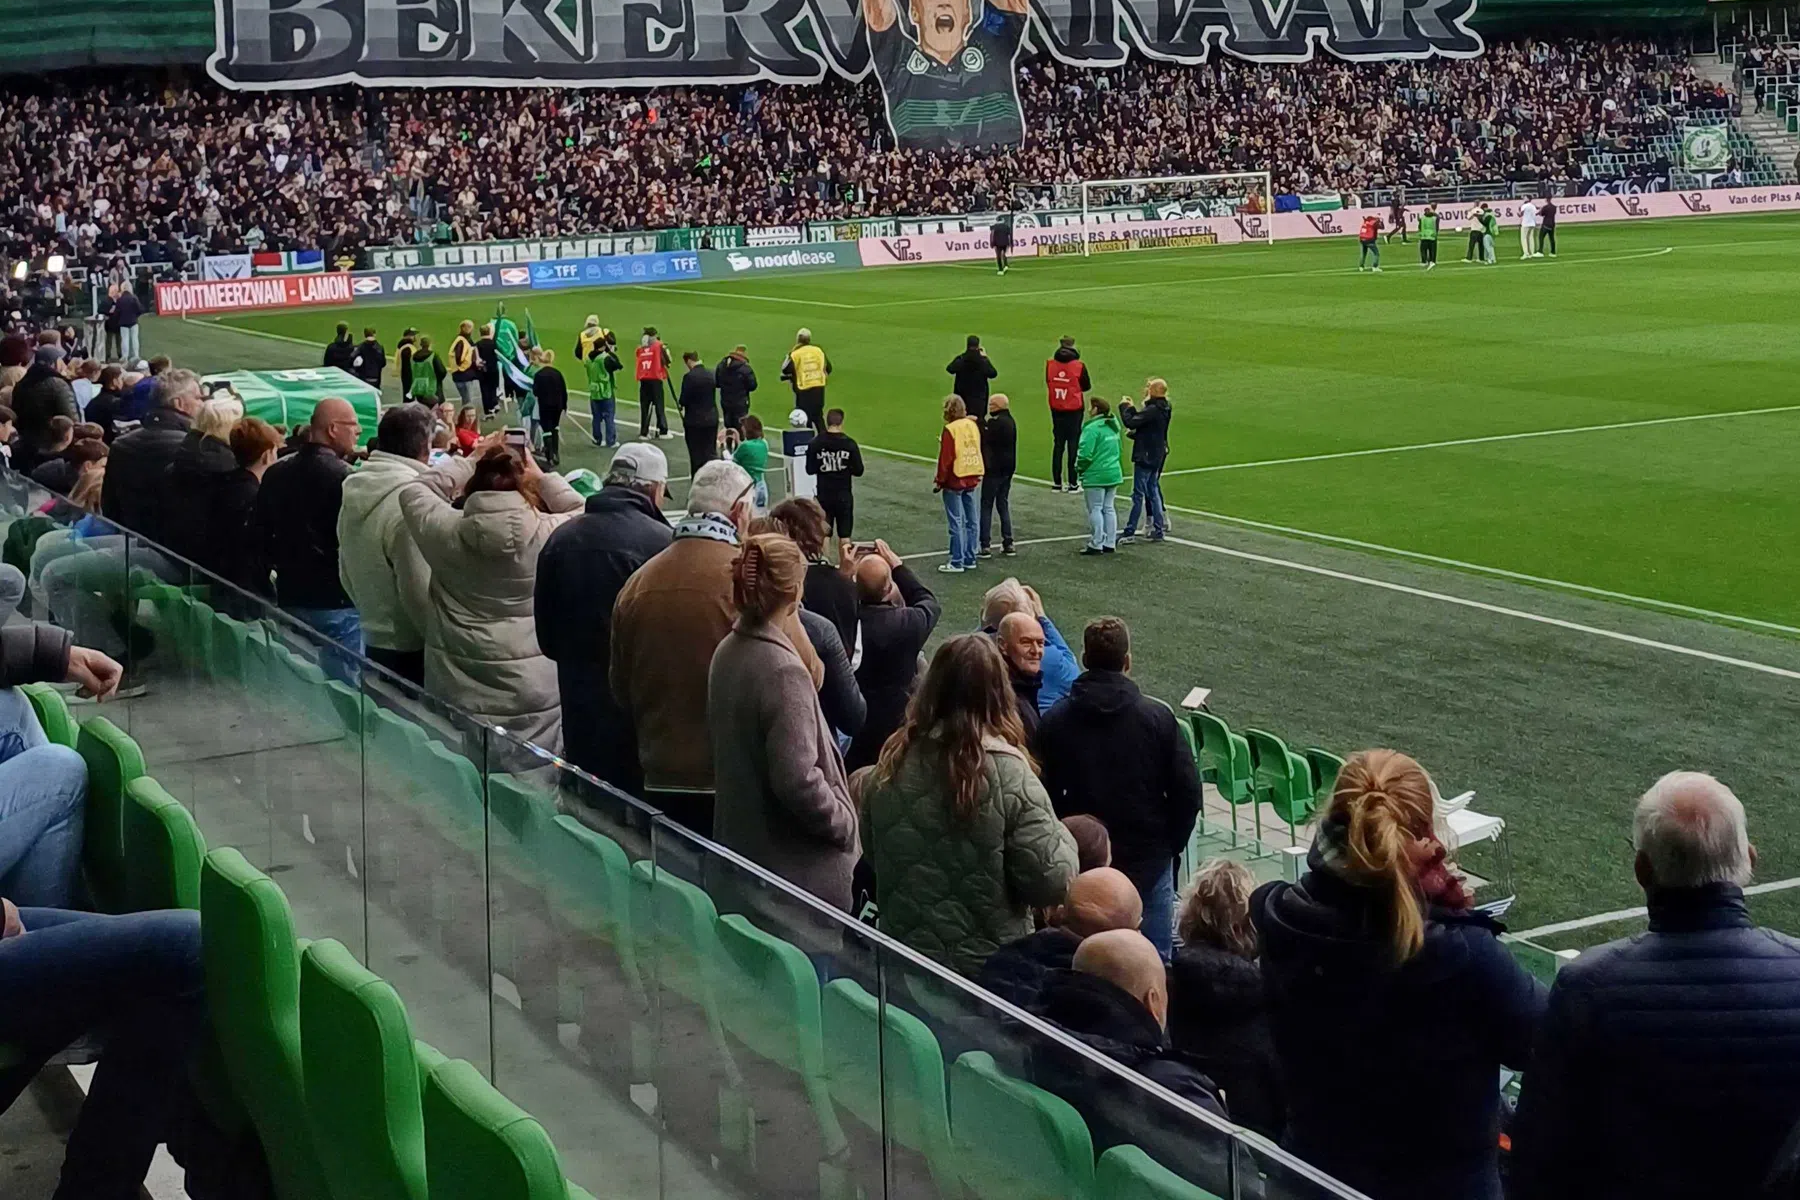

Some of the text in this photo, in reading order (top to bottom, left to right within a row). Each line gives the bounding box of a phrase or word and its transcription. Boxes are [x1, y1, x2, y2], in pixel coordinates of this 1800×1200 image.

[1728, 194, 1748, 204] Van
[1751, 193, 1767, 203] der
[1770, 191, 1791, 202] Plas
[1506, 207, 1513, 218] &
[945, 240, 970, 252] Van
[974, 238, 992, 250] de
[1110, 229, 1119, 241] &
[670, 257, 698, 271] TFF
[754, 249, 836, 269] noordlease
[554, 264, 578, 277] TFF
[393, 271, 494, 292] AMASUS.nl
[160, 279, 287, 312] NOOITMEERZWAM
[300, 275, 350, 302] LAMON
[641, 360, 653, 371] TV
[1054, 387, 1068, 401] TV
